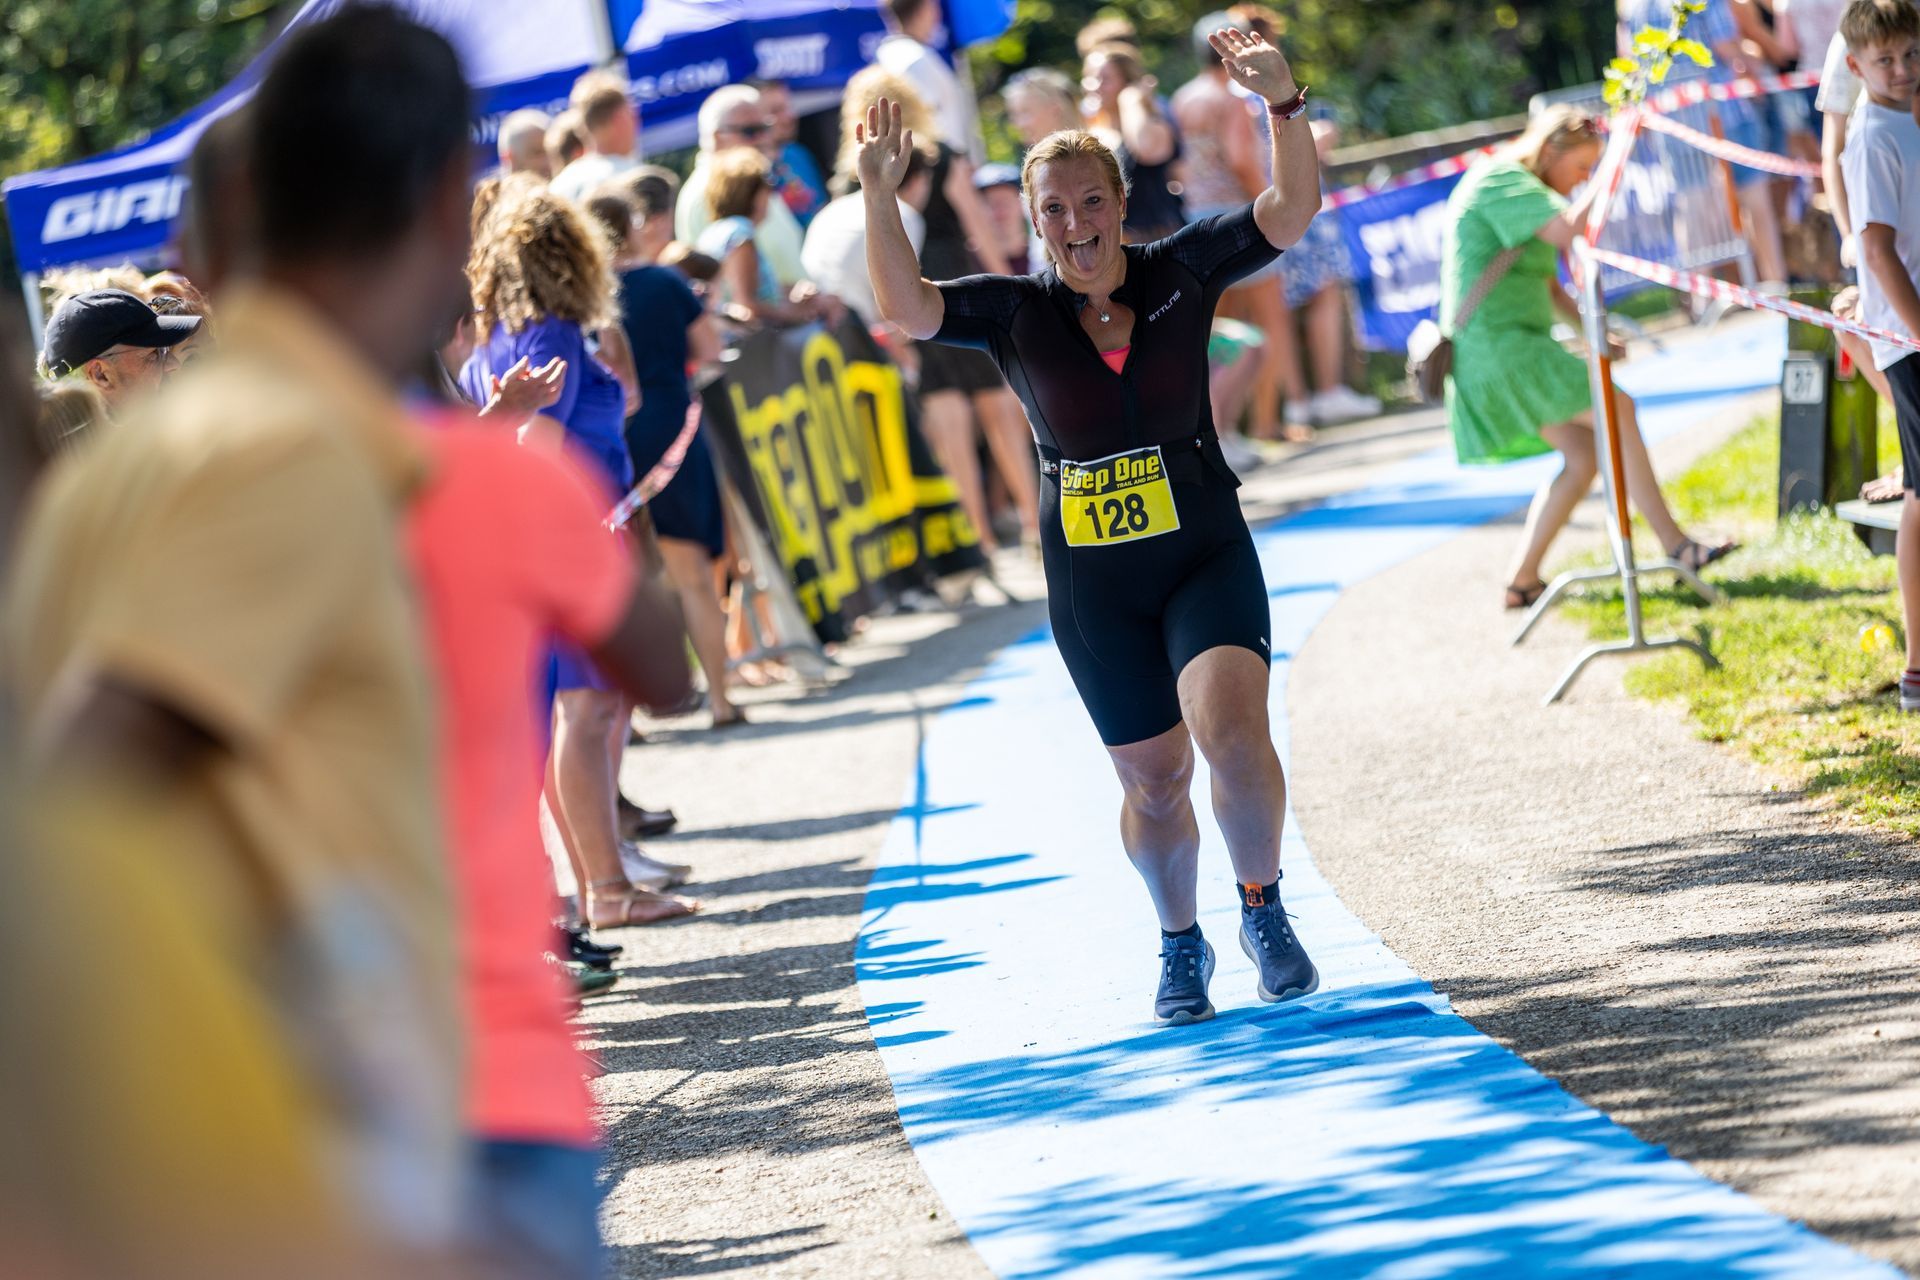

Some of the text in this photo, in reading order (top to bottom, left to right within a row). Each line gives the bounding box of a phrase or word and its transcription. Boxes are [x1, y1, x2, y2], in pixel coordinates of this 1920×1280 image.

[1062, 465, 1110, 494] Step
[1114, 454, 1160, 482] One
[1116, 481, 1133, 489] TRAIL
[1133, 477, 1147, 486] AND
[1084, 492, 1150, 540] 128
